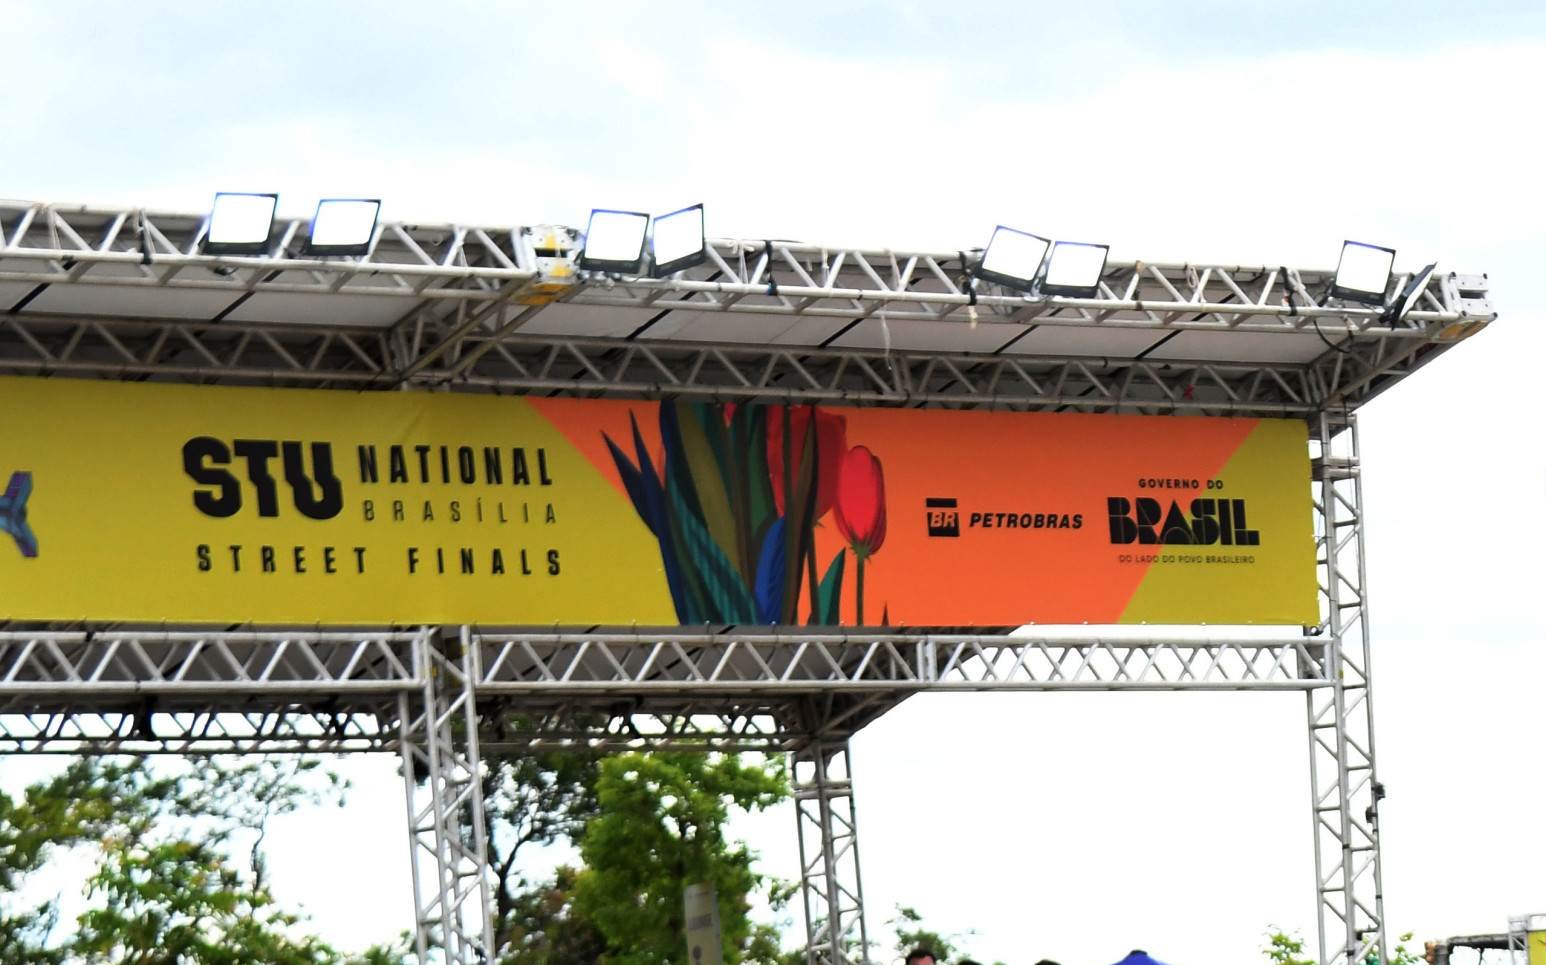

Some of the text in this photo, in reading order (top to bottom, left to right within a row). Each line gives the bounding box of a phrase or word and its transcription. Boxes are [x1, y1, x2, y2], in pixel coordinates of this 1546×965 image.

[183, 436, 344, 520] STU
[358, 445, 552, 485] NATIONAL
[1138, 478, 1224, 490] GOVERNO DO
[362, 497, 557, 525] BRASÍLIA
[969, 512, 1084, 530] PETROBRAS
[1106, 496, 1260, 546] BRASIL
[196, 544, 561, 576] STREET FINALS
[1118, 554, 1255, 565] DO LADO DO POVO BRASILEIRO
